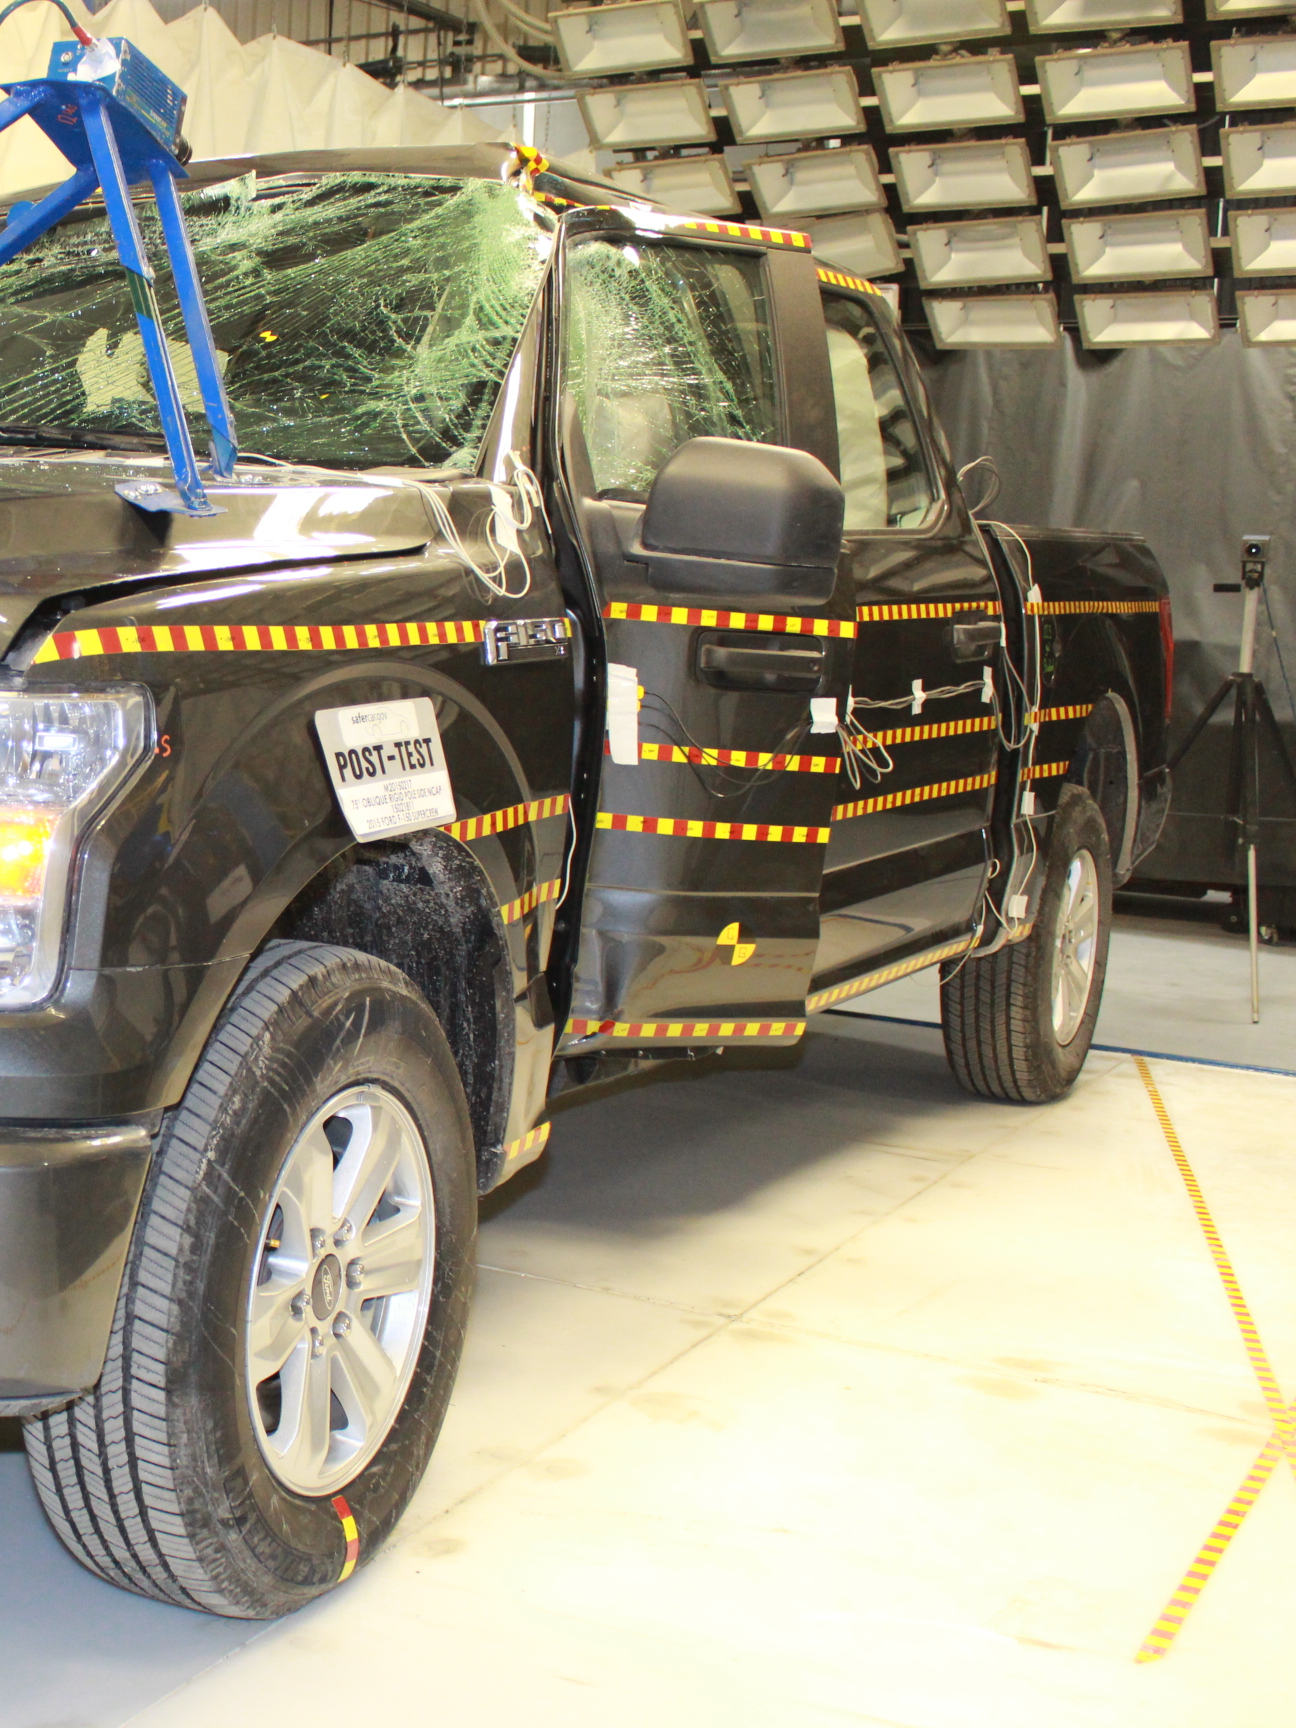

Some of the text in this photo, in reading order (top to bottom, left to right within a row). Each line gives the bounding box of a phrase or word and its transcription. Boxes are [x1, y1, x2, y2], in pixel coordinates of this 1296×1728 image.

[351, 711, 388, 725] safercar.gov
[334, 737, 435, 783] POST-TEST
[362, 794, 388, 808] OBLIQUE
[389, 791, 404, 803] RIGID
[404, 789, 417, 800] POLE
[417, 787, 427, 799] SIDE
[427, 785, 442, 796] NCAP
[366, 818, 381, 829] 2015
[381, 815, 397, 826] FORD
